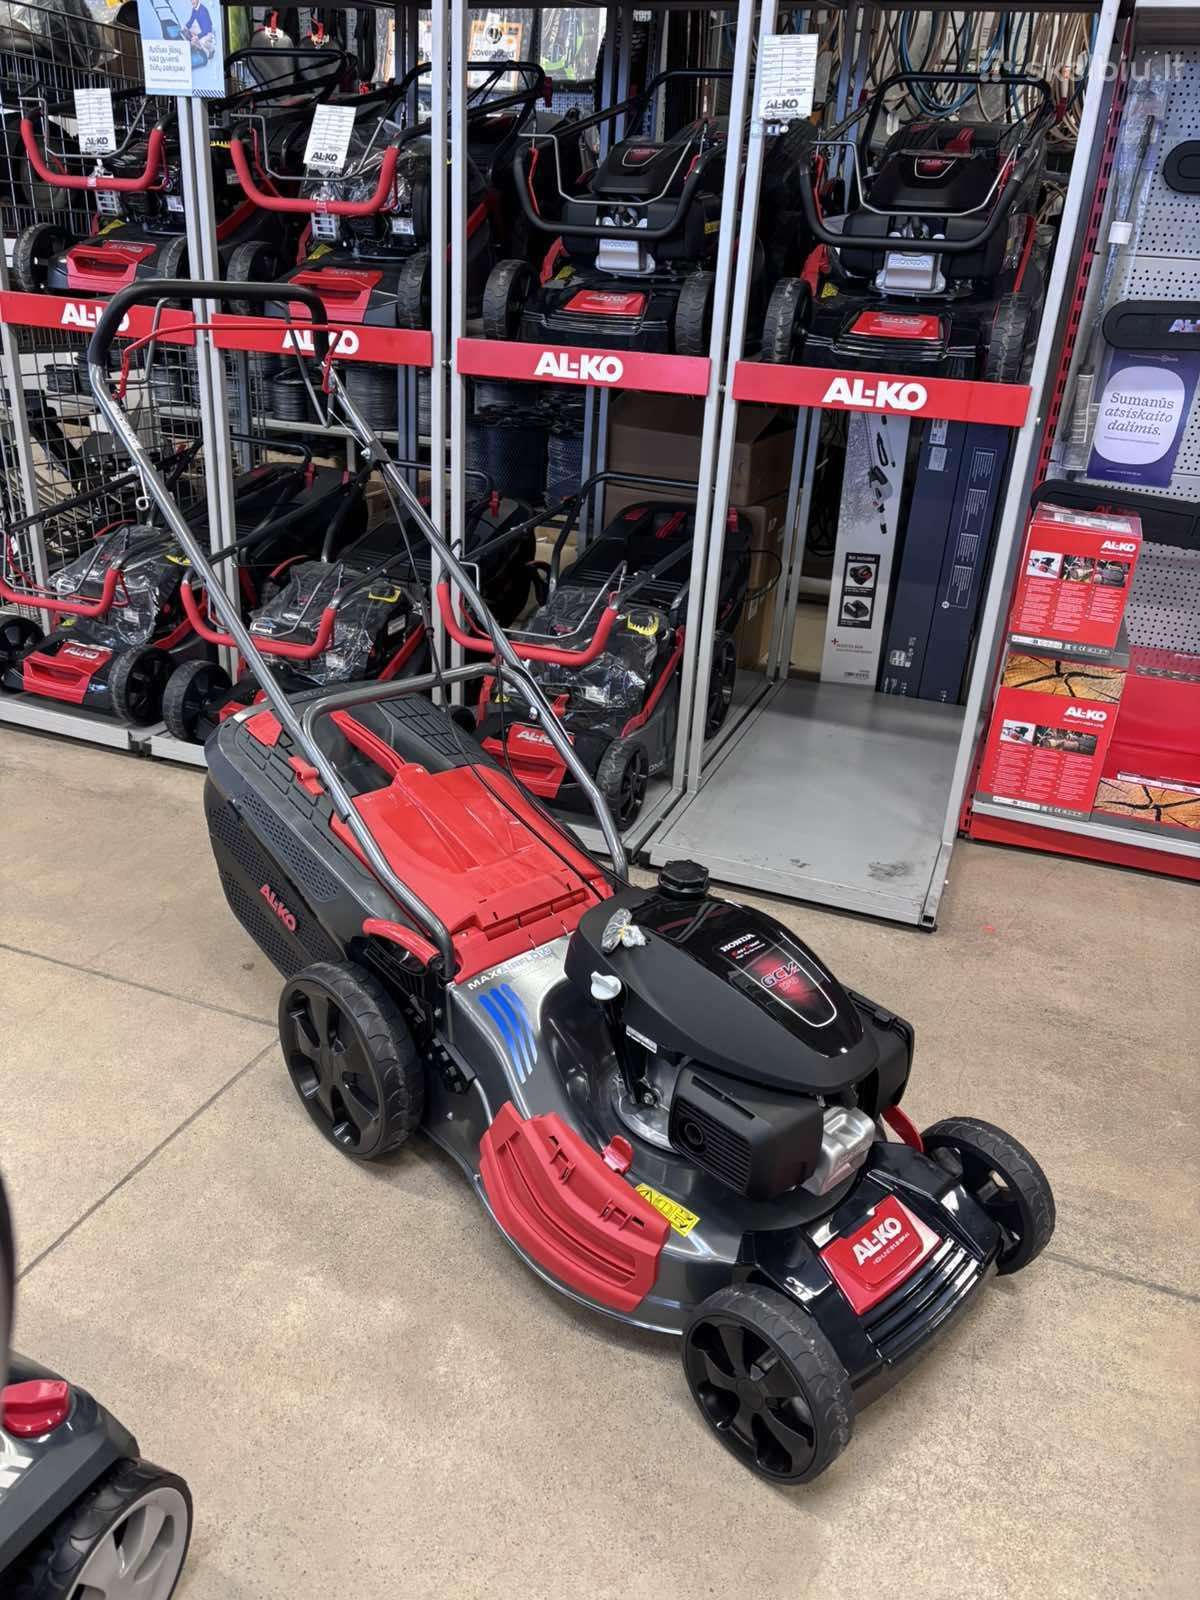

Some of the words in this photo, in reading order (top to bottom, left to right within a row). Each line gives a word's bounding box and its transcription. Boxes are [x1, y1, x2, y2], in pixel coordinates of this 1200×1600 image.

[764, 98, 799, 110] AL-KO
[311, 151, 338, 162] AL-KO
[534, 351, 624, 383] AL-KO
[822, 377, 928, 411] AL-KO
[1110, 392, 1175, 410] Sumanūs
[1104, 407, 1173, 423] atsiskaito
[1107, 419, 1161, 437] dalimis.
[1100, 540, 1137, 553] AL-KO
[1064, 706, 1108, 721] AL-KO
[259, 883, 297, 932] AL-KO
[719, 933, 757, 953] HONDA
[852, 1217, 902, 1266] AL-KO
